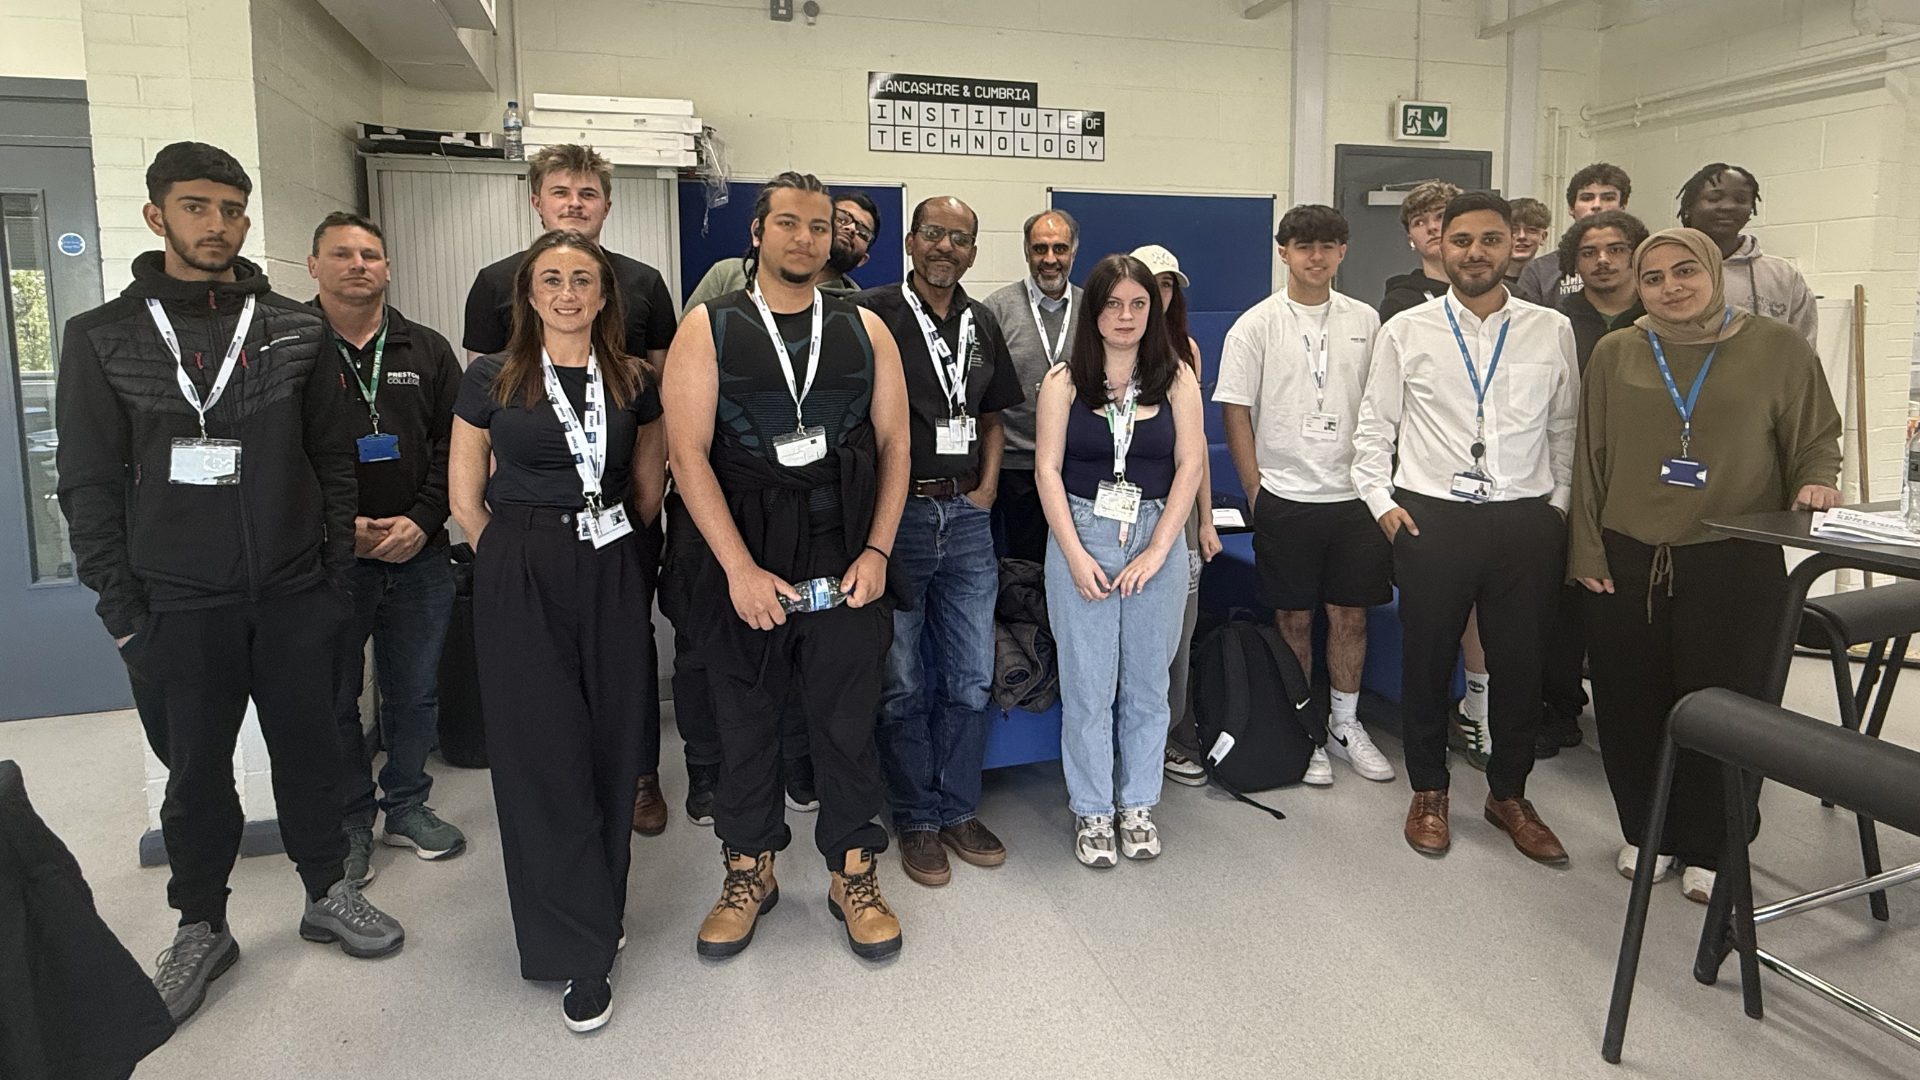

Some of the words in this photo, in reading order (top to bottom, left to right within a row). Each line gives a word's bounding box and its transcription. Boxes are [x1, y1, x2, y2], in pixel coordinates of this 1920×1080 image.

[877, 79, 960, 97] LANCASHIRE
[962, 85, 971, 97] &
[974, 85, 1031, 101] CUMBRIA
[877, 104, 1076, 129] INSTITUTE
[1085, 117, 1101, 130] OF
[877, 130, 1098, 155] TECHNOLOGY
